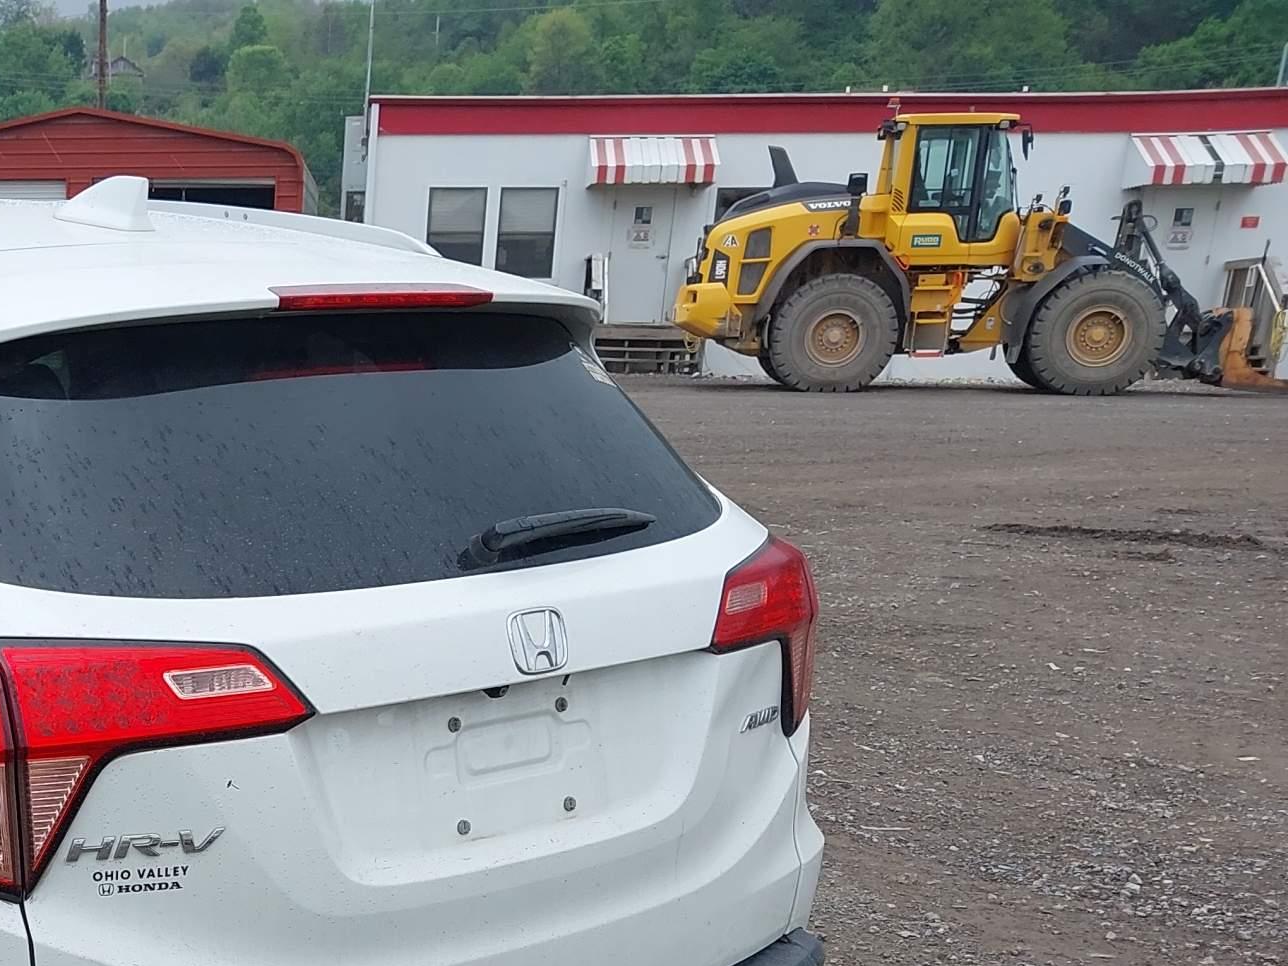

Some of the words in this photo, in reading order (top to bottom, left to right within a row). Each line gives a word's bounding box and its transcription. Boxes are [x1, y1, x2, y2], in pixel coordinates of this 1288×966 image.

[808, 200, 852, 209] VOLVO
[715, 260, 727, 279] L90H
[66, 826, 225, 863] HR-V
[92, 869, 131, 882] OHIO
[137, 865, 190, 880] VALLEY
[117, 881, 183, 894] HONDA
